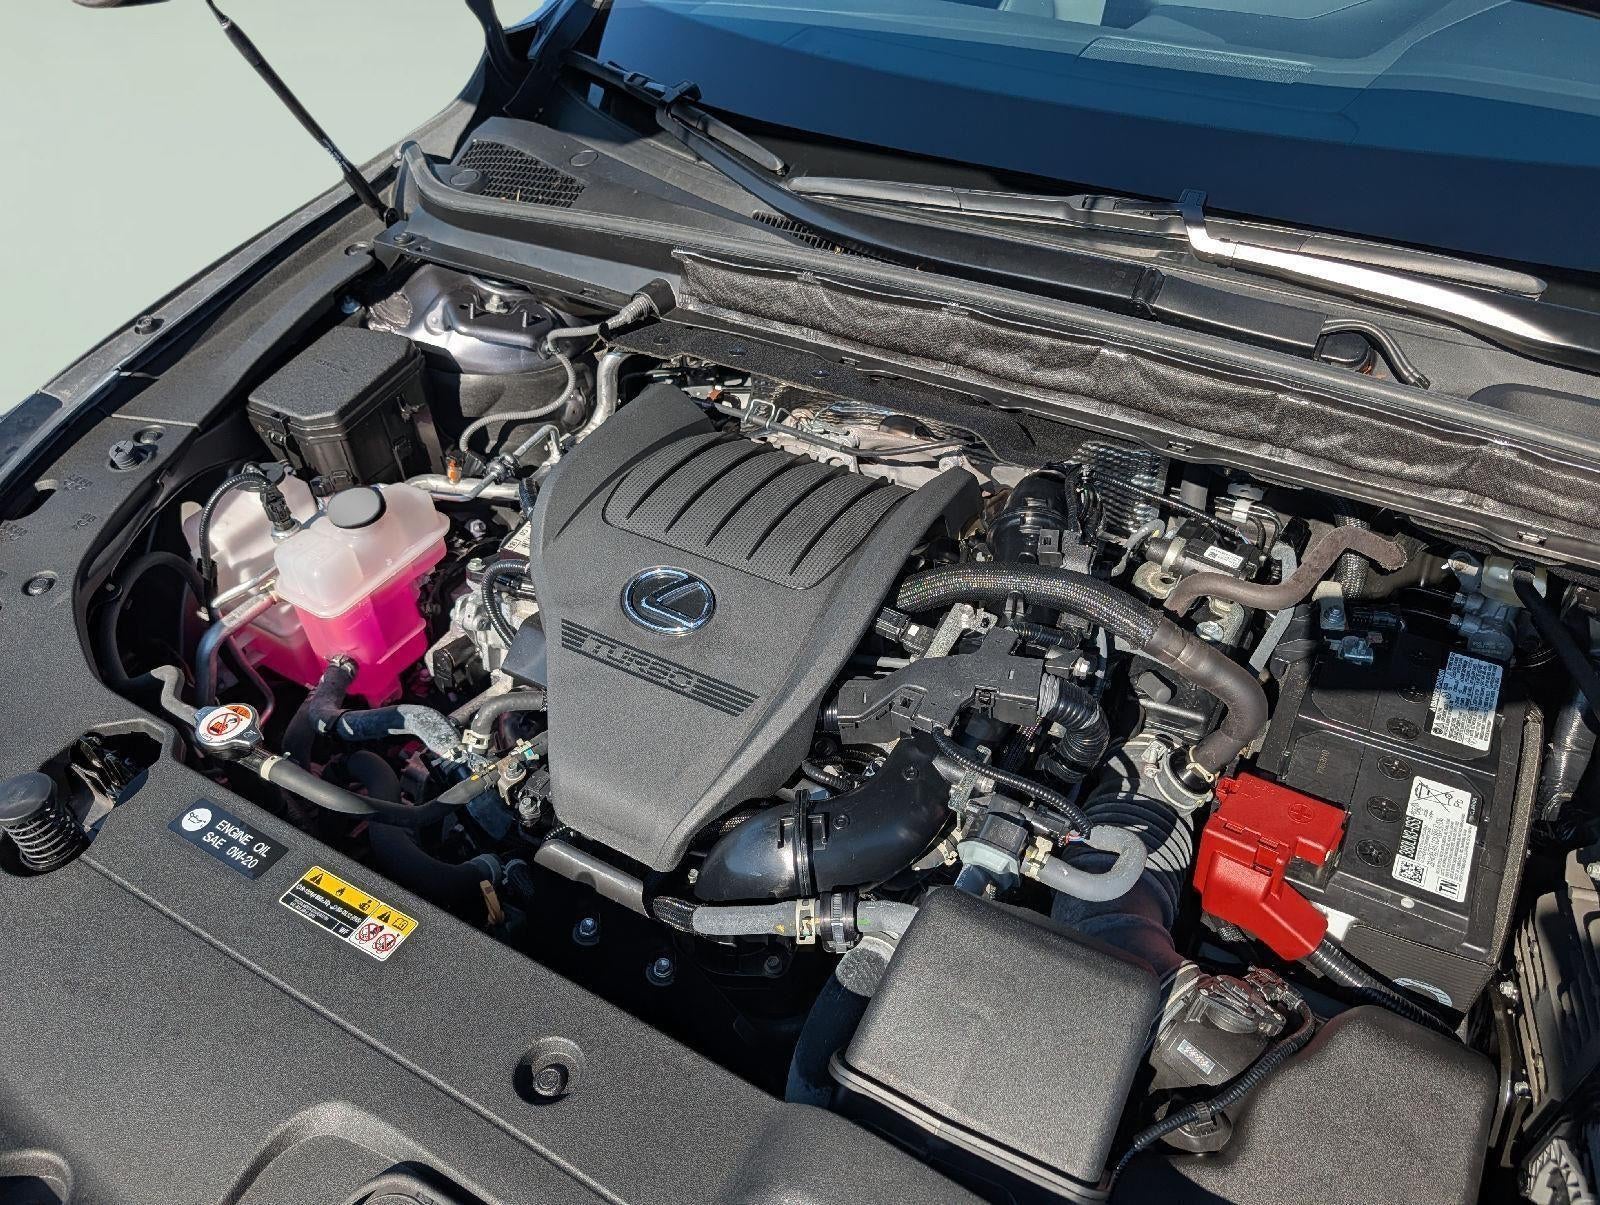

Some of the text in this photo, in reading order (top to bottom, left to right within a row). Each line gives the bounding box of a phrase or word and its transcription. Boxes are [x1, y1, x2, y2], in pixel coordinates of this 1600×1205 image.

[580, 633, 696, 690] TURBO
[202, 831, 258, 869] SAE 0W-20
[216, 820, 271, 858] ENGINE OIL
